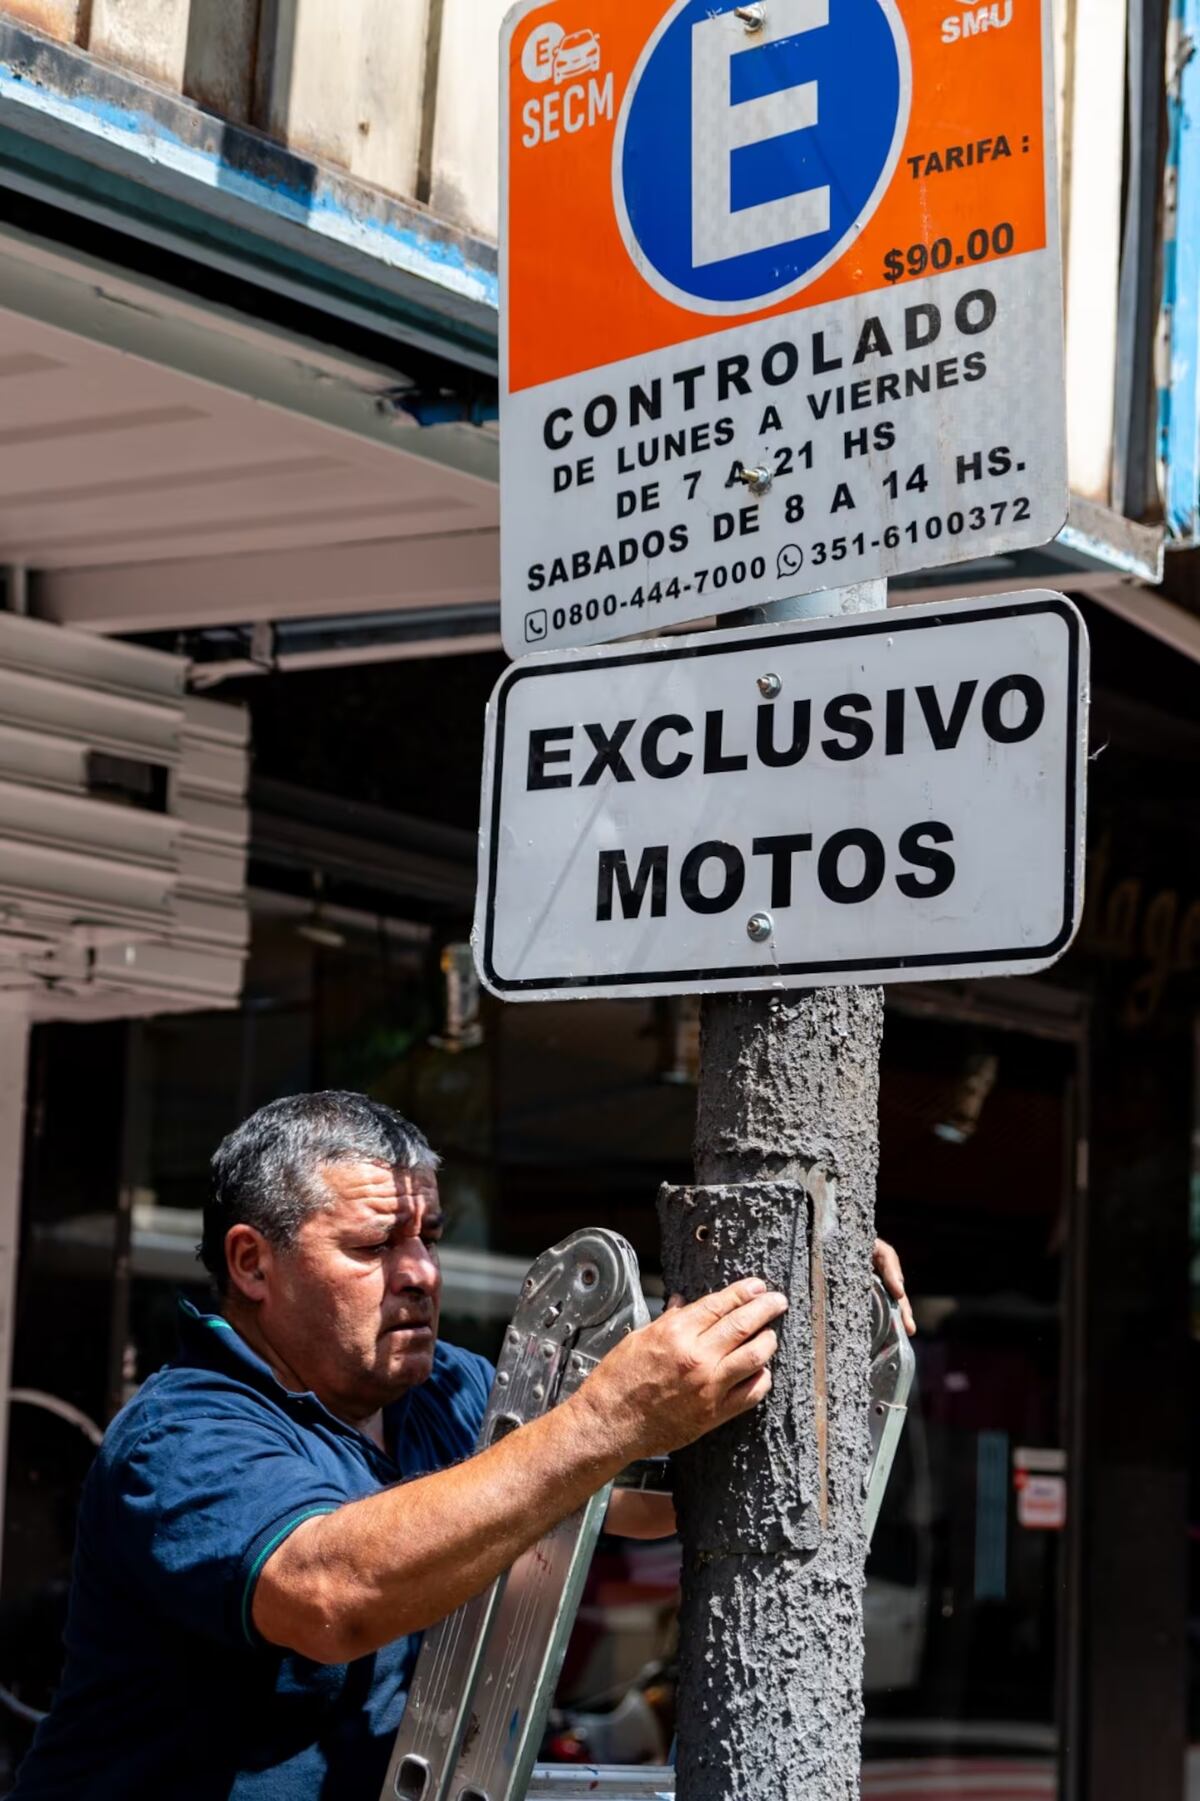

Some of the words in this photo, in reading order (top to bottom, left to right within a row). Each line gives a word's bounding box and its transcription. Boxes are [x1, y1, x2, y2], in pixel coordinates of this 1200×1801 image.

[535, 36, 550, 67] E
[941, 0, 1013, 44] SMU
[522, 71, 614, 148] SECM
[690, 0, 831, 268] E
[907, 134, 1012, 179] TARIFA
[883, 222, 1014, 284] $90.00
[542, 288, 998, 451] CONTROLADO
[553, 456, 595, 493] DE
[617, 417, 735, 474] LUNES
[758, 405, 783, 436] A
[806, 351, 987, 421] VIERNES
[616, 481, 660, 519] DE
[683, 470, 702, 500] 7
[724, 460, 750, 489] A
[773, 440, 813, 478] 21
[843, 421, 896, 460] HS
[527, 523, 689, 592] SABADOS
[713, 504, 760, 543] DE
[784, 494, 805, 524] 8
[829, 482, 856, 514] A
[882, 463, 929, 500] 14
[956, 446, 1026, 485] HS.
[552, 556, 766, 631] 0800-444-7000
[811, 497, 1031, 566] 351-6100372
[526, 673, 1045, 792] EXCLUSIVO
[595, 820, 956, 922] MOTOS
